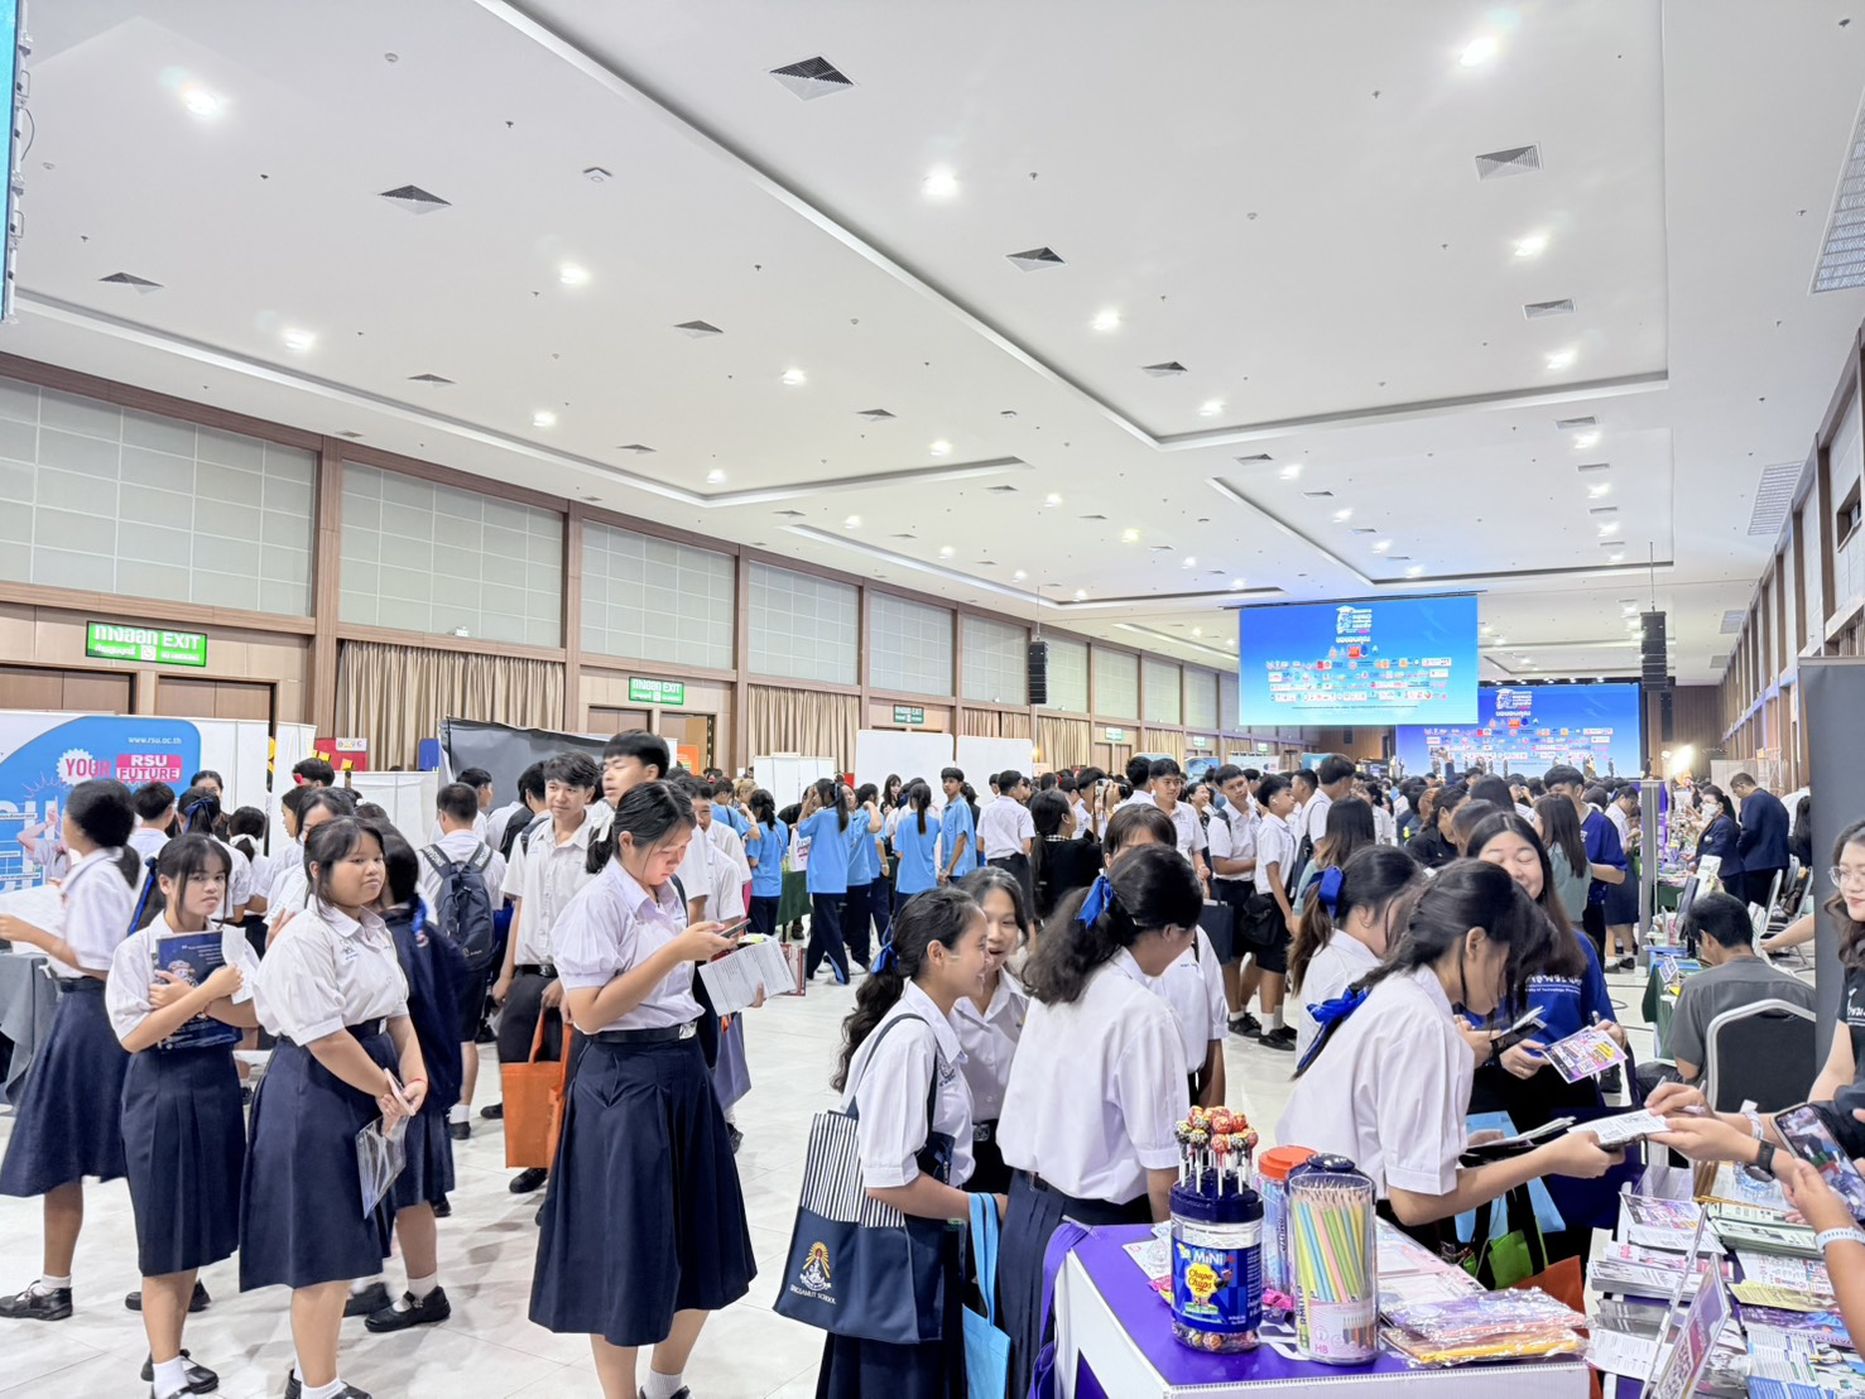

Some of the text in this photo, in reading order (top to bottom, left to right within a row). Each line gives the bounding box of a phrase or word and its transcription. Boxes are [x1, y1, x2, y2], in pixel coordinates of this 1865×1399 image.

[94, 625, 200, 650] ทางออก EXIT
[662, 682, 681, 694] EXIT
[131, 755, 167, 767] RSU
[66, 758, 112, 778] YOUR
[120, 768, 177, 779] FUTURE
[818, 1293, 836, 1304] SCHOOL
[1315, 1343, 1328, 1354] HB
